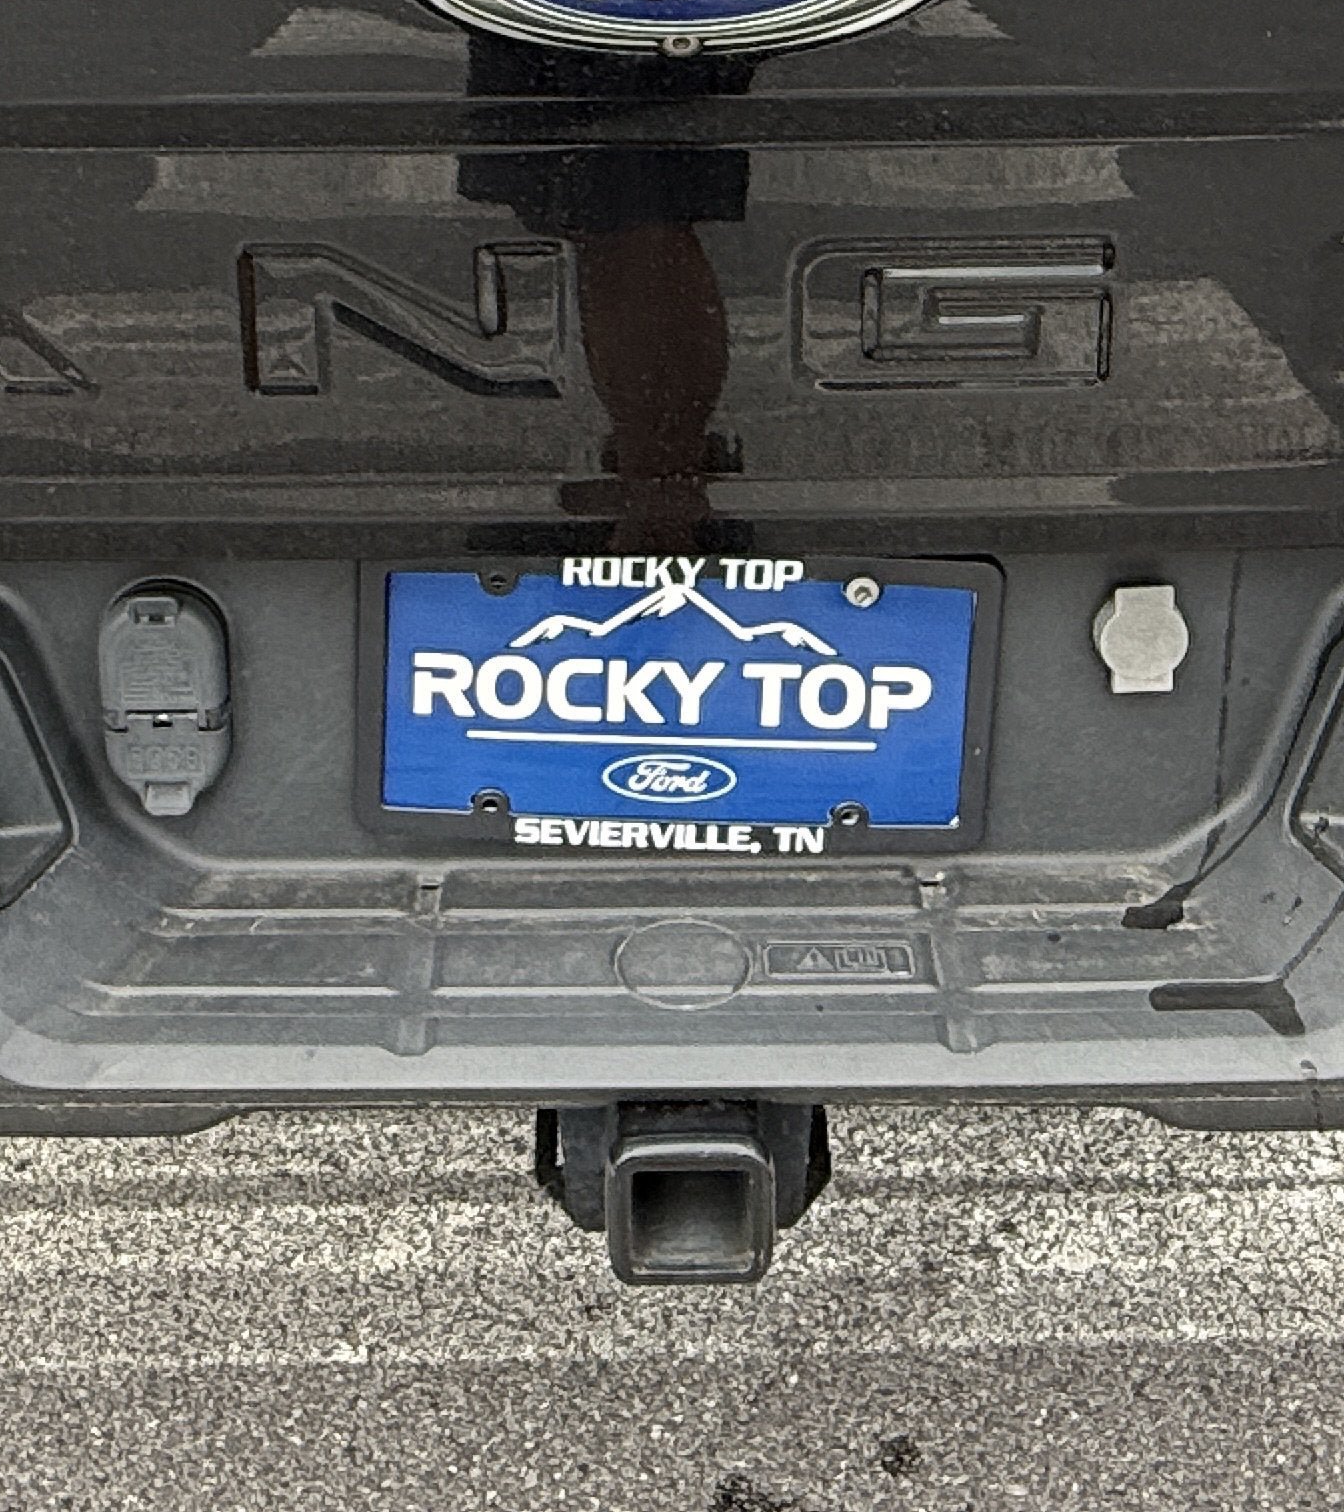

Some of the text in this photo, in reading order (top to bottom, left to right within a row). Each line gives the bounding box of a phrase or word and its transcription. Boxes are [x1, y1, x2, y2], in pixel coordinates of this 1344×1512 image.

[562, 556, 805, 591] ROCKY TOP
[412, 651, 934, 730] ROCKY TOP
[627, 758, 711, 795] Ford
[514, 817, 826, 854] SEVIERVILLE, TN
